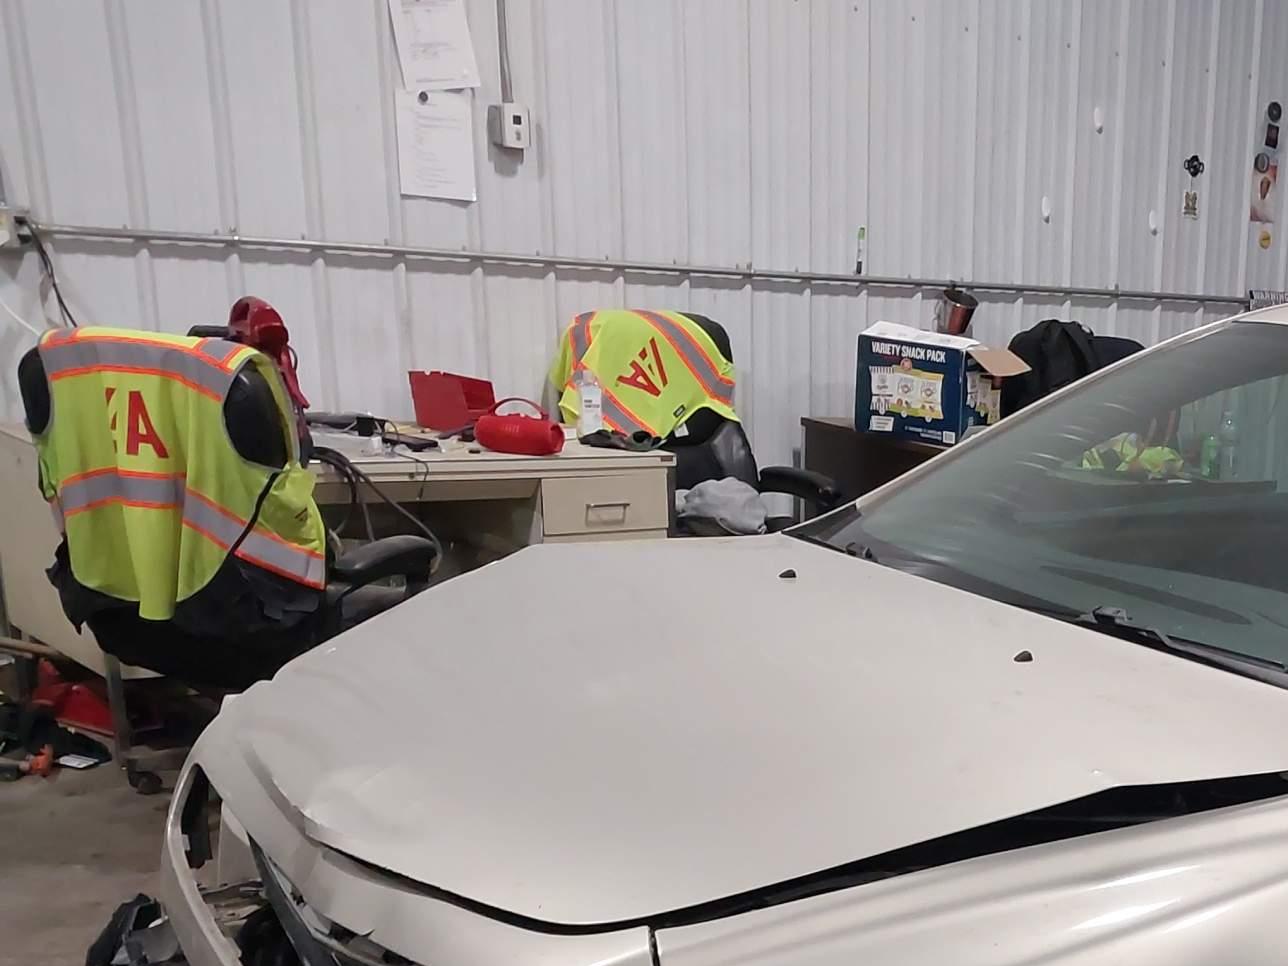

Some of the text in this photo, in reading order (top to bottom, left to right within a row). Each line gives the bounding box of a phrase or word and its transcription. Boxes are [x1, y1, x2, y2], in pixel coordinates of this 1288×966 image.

[871, 341, 946, 363] VARIETY SNACK PACK
